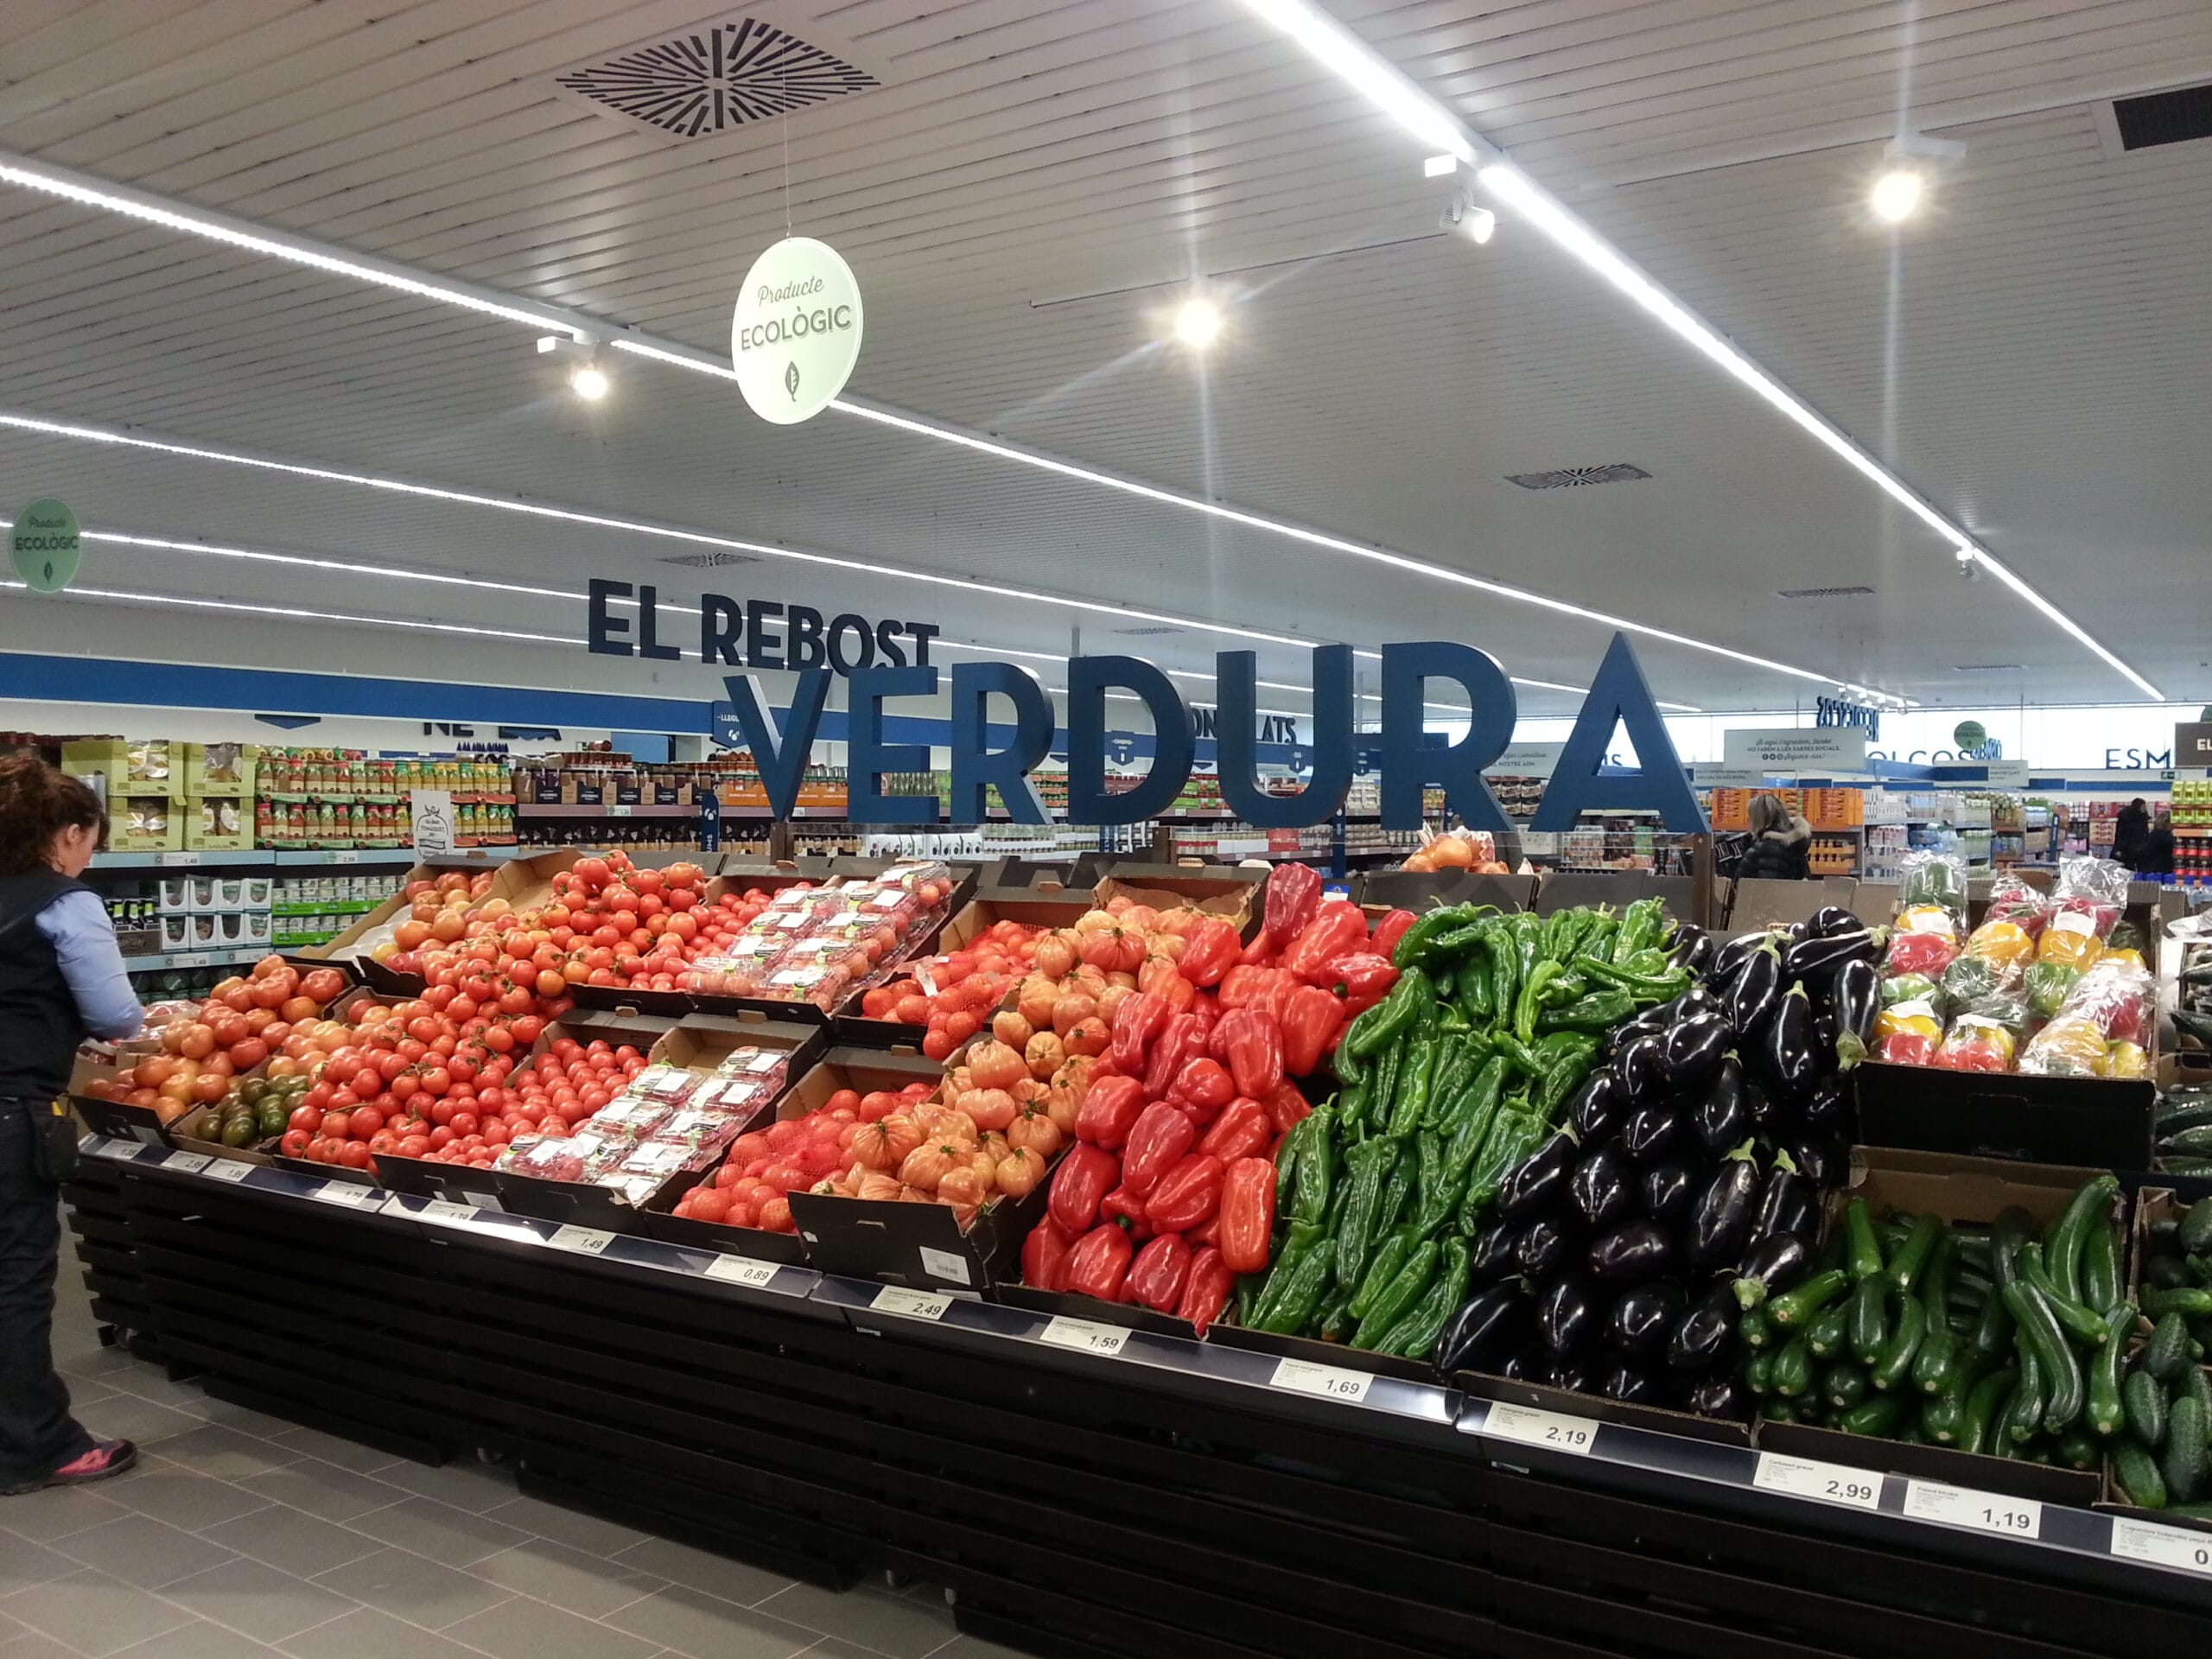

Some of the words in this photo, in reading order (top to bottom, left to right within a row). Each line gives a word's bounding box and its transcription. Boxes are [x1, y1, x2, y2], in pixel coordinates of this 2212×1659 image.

[758, 276, 824, 306] Producte
[741, 304, 852, 351] ECOLÒGIC
[15, 531, 79, 550] ECOLÒGIC
[588, 578, 680, 660] EL
[701, 593, 939, 678] REBOST
[722, 632, 1711, 833] VERDURA
[580, 1237, 604, 1250] 1,49
[742, 1268, 771, 1281] 0,89
[912, 1302, 943, 1316] 2,49
[1088, 1334, 1120, 1349] 1,59
[1326, 1378, 1361, 1395] 1,69
[1545, 1426, 1587, 1445] 2,19
[1825, 1479, 1872, 1500] 2,99
[1981, 1508, 2031, 1529] 1,19
